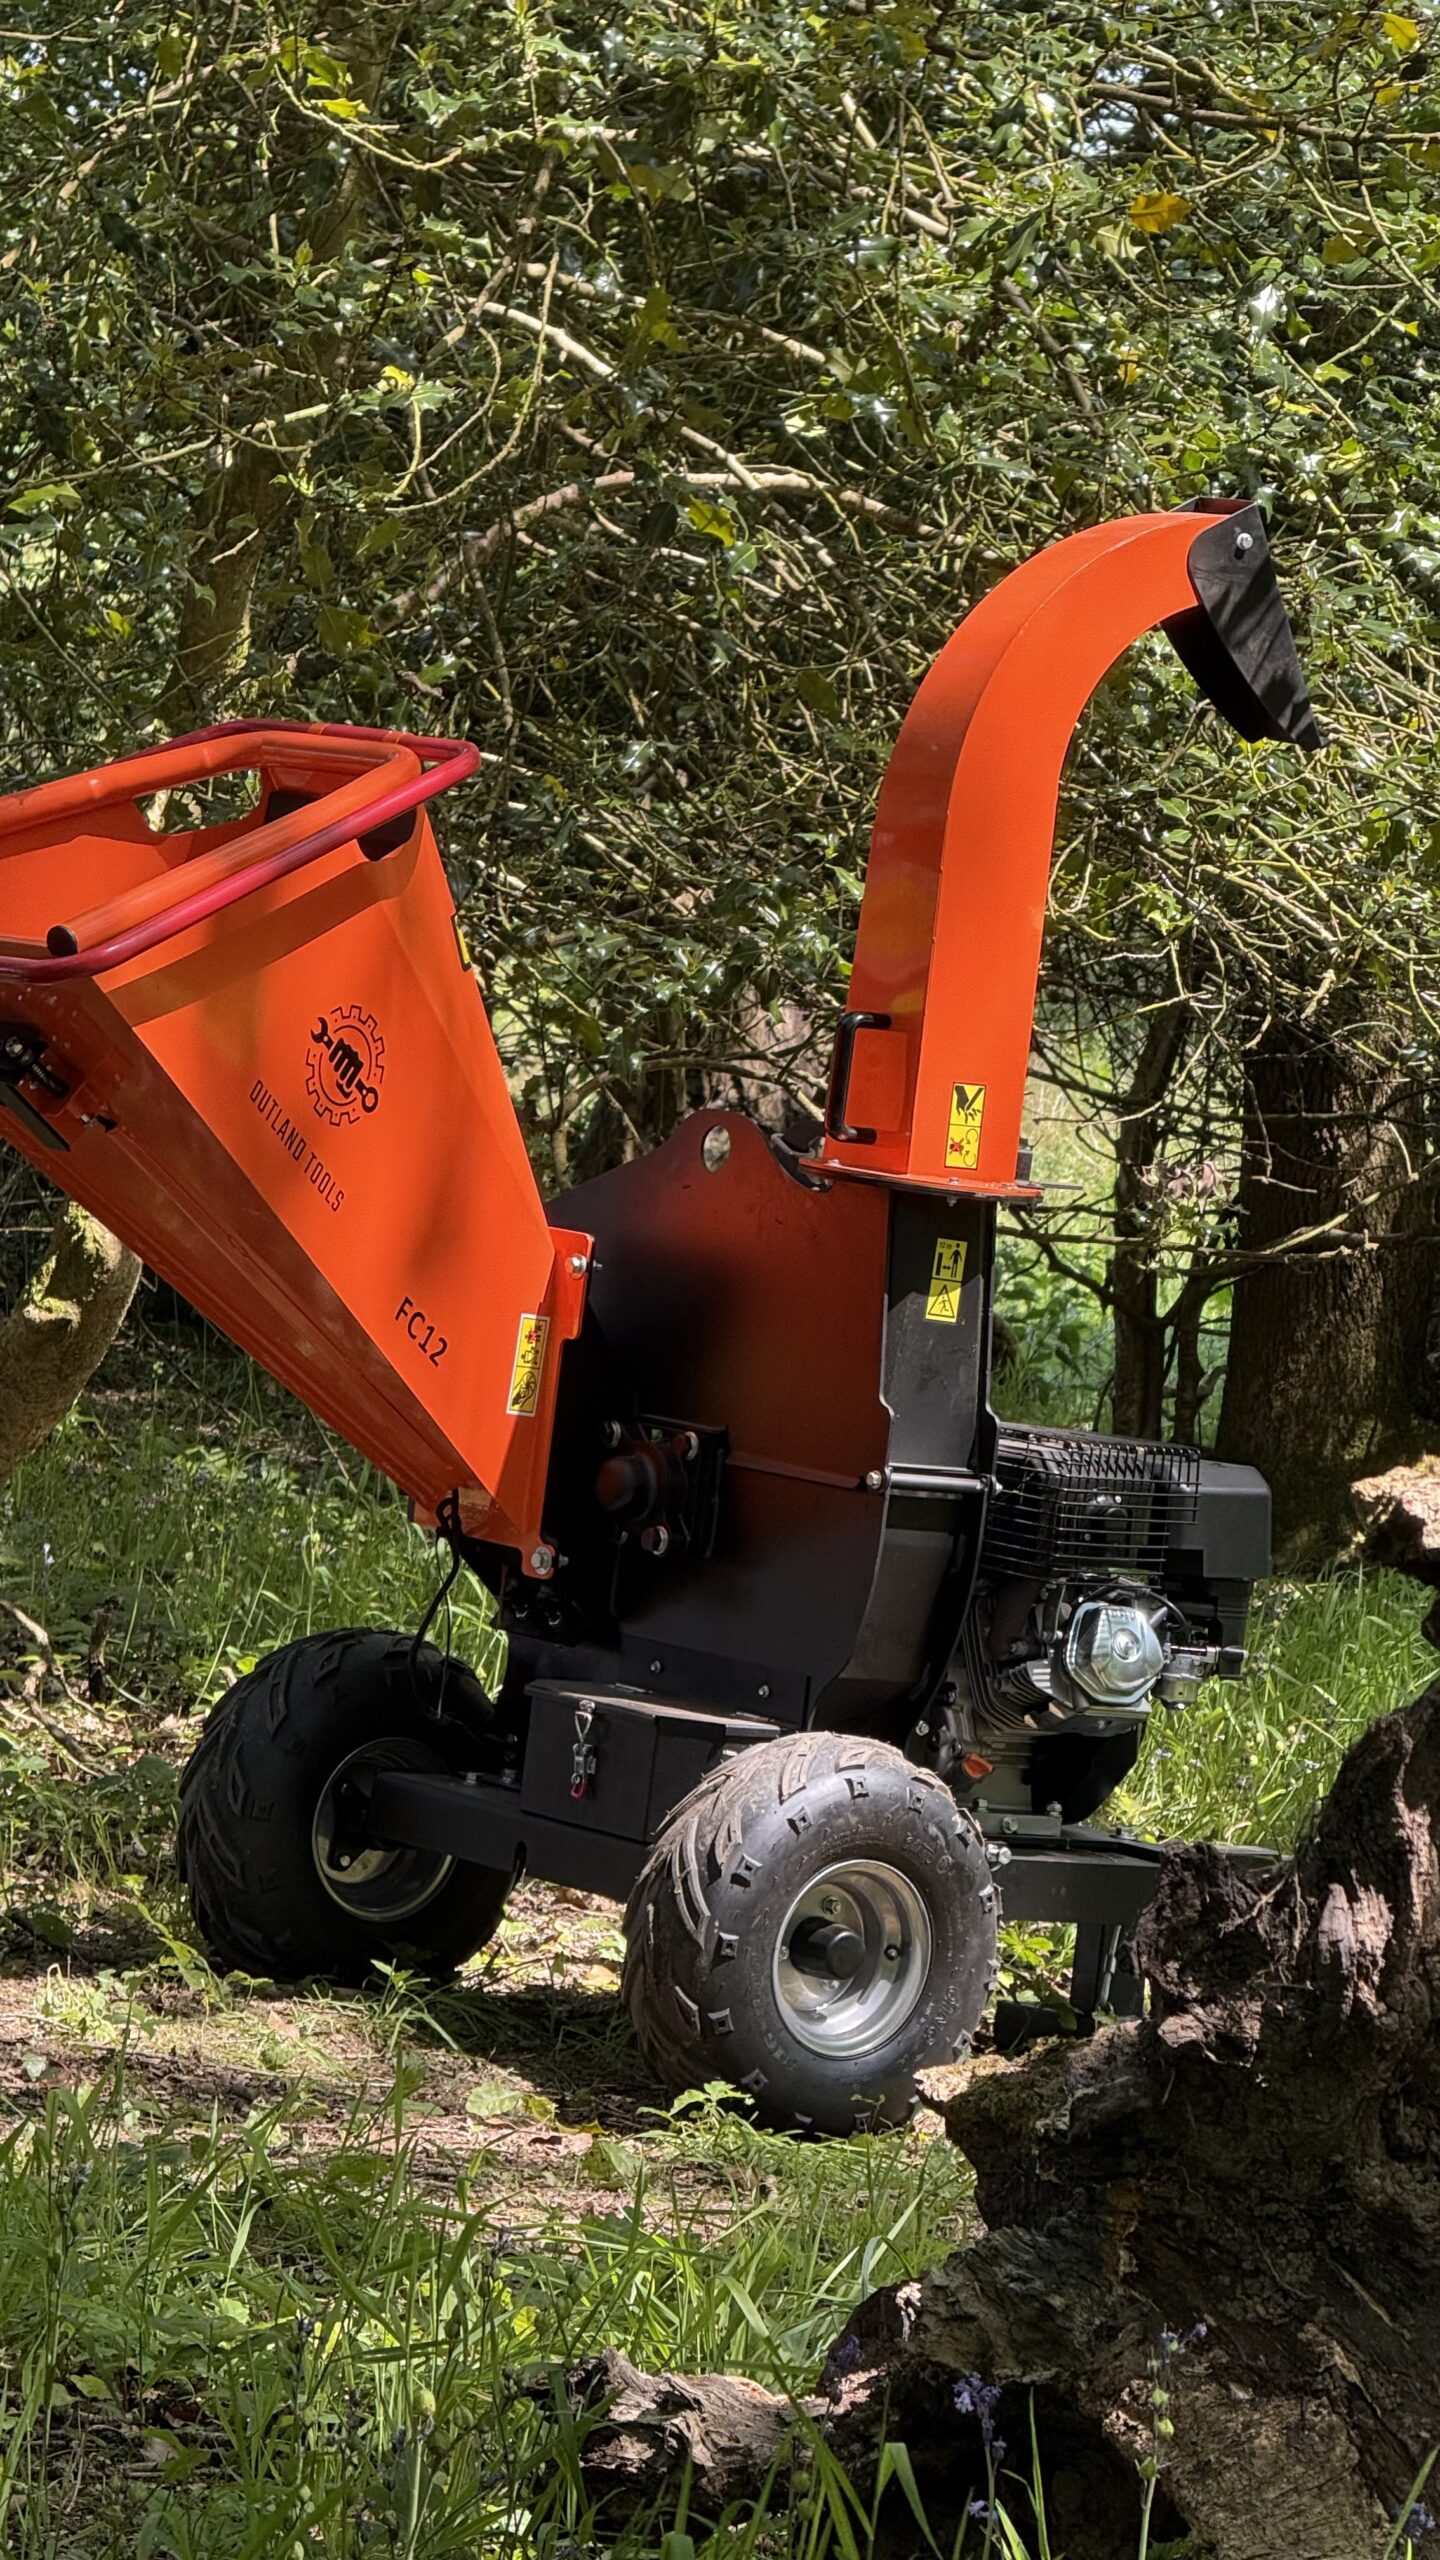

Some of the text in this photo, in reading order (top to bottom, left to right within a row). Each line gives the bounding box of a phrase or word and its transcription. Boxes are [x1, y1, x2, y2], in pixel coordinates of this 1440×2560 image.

[249, 1079, 345, 1212] OUTLAND TOOLS
[395, 1296, 448, 1367] FC12
